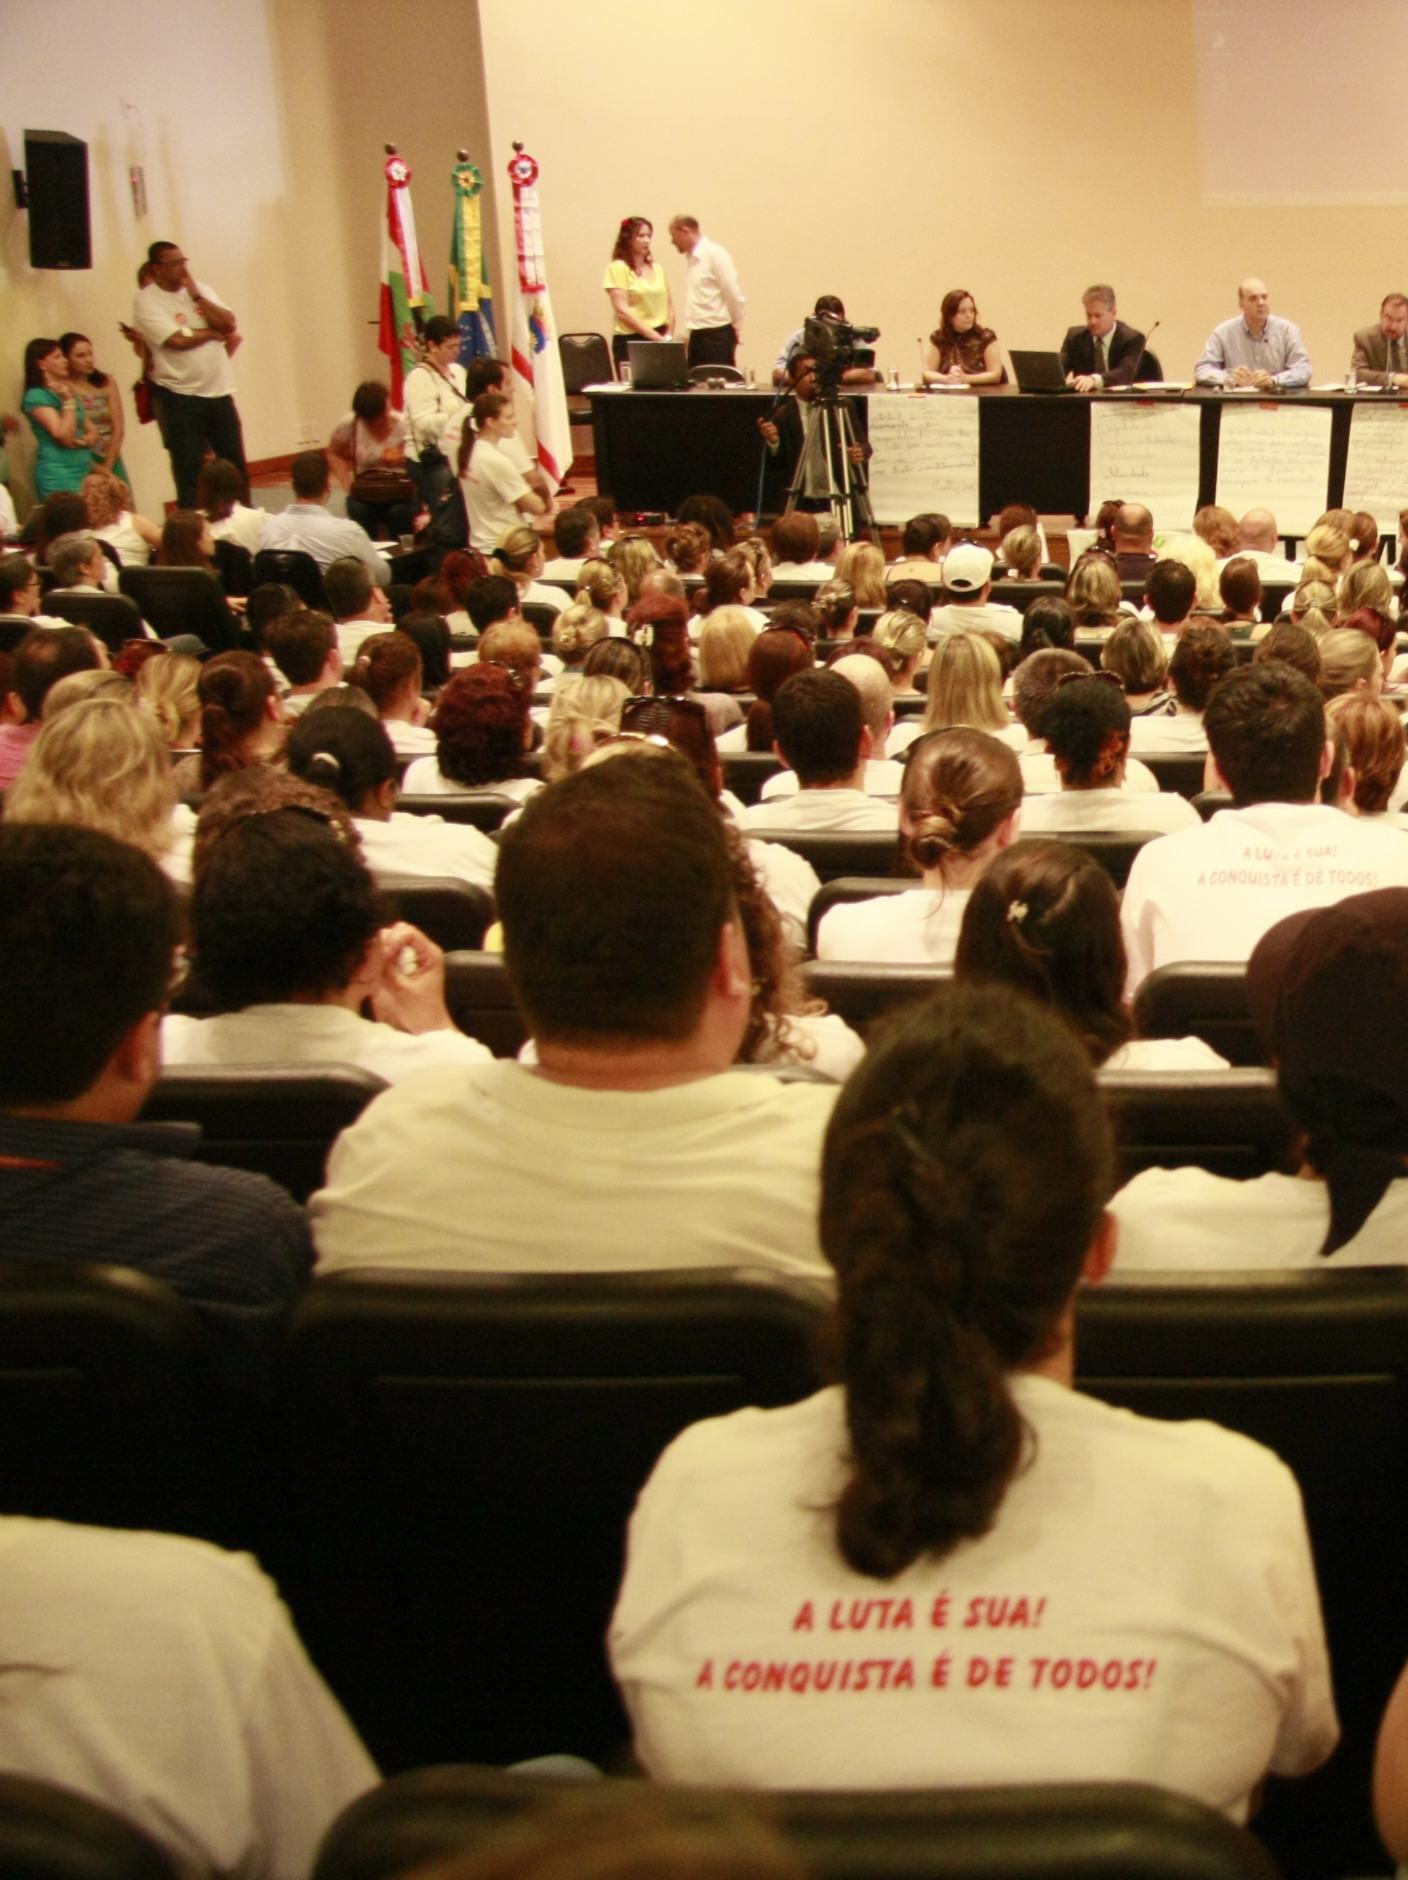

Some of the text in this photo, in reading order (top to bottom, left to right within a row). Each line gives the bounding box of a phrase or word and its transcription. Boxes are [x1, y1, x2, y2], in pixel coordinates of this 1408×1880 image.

[1243, 846, 1251, 859] A
[1305, 844, 1338, 859] SUA!
[1197, 868, 1379, 889] A CONQUISTA É DE TODOS!
[793, 1590, 1048, 1632] A LUTA É SUA!
[696, 1649, 1157, 1693] A CONQUISTA É DE TODOS!
